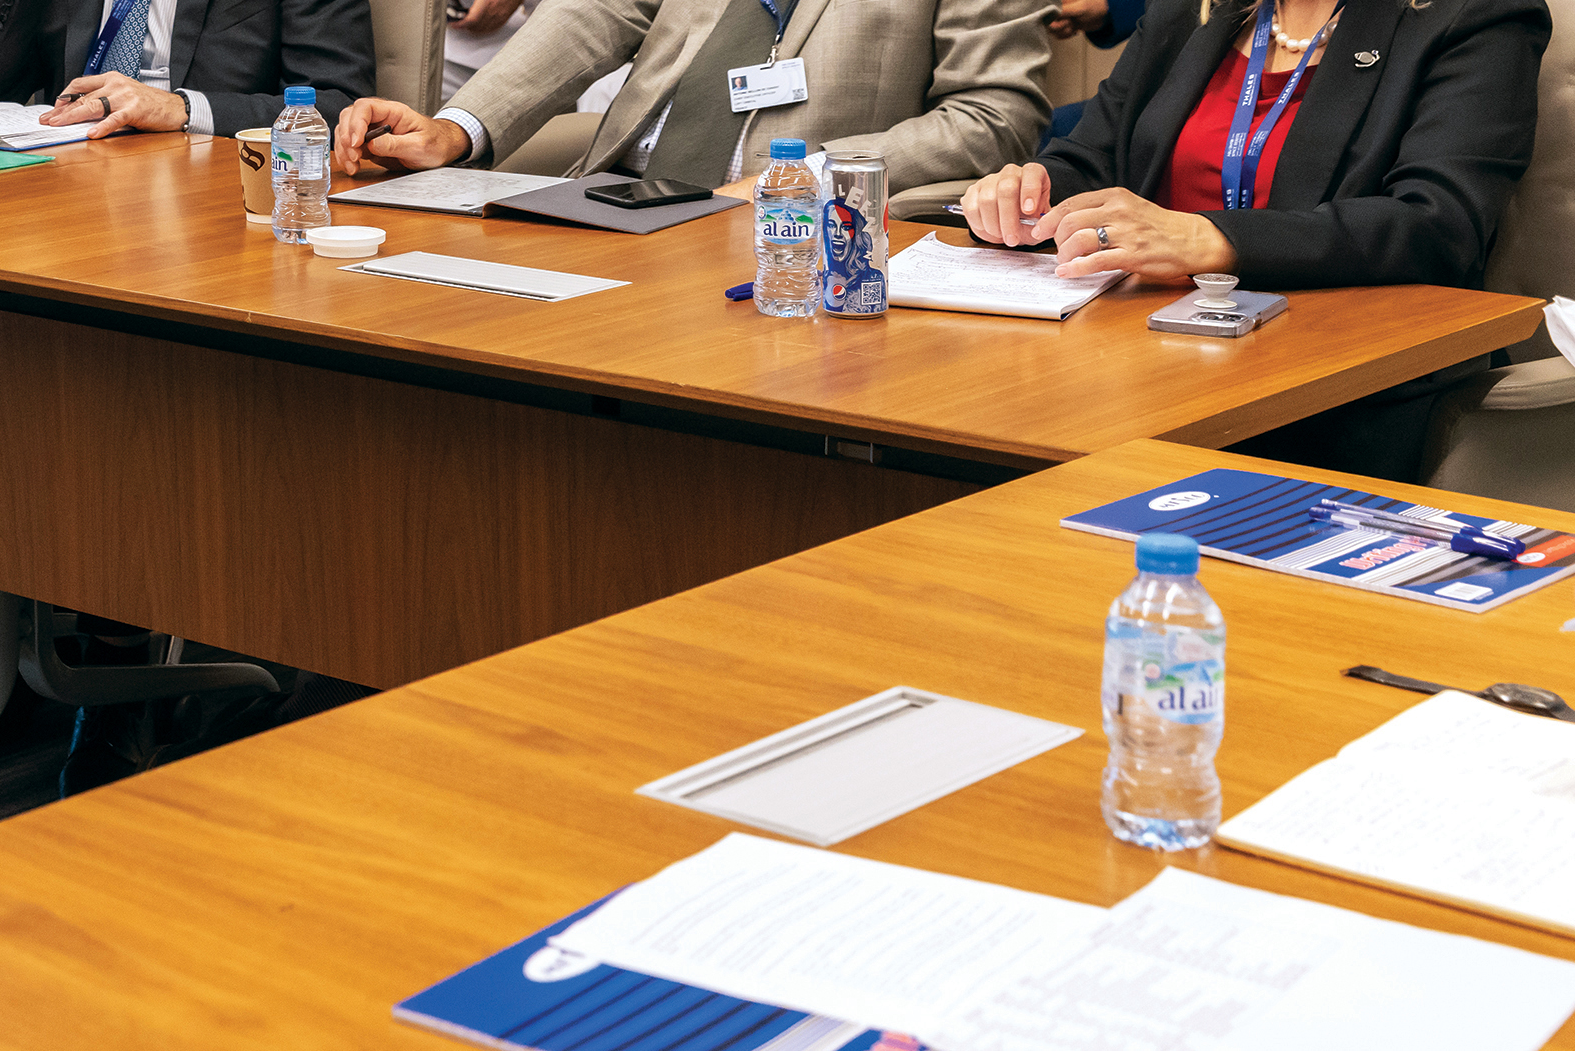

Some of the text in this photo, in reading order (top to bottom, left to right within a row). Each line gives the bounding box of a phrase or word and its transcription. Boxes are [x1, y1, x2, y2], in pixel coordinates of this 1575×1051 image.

[89, 39, 106, 68] THALES
[1242, 73, 1256, 106] THALES
[1278, 71, 1300, 105] THALES
[763, 221, 810, 238] al ain
[1157, 685, 1186, 710] al
